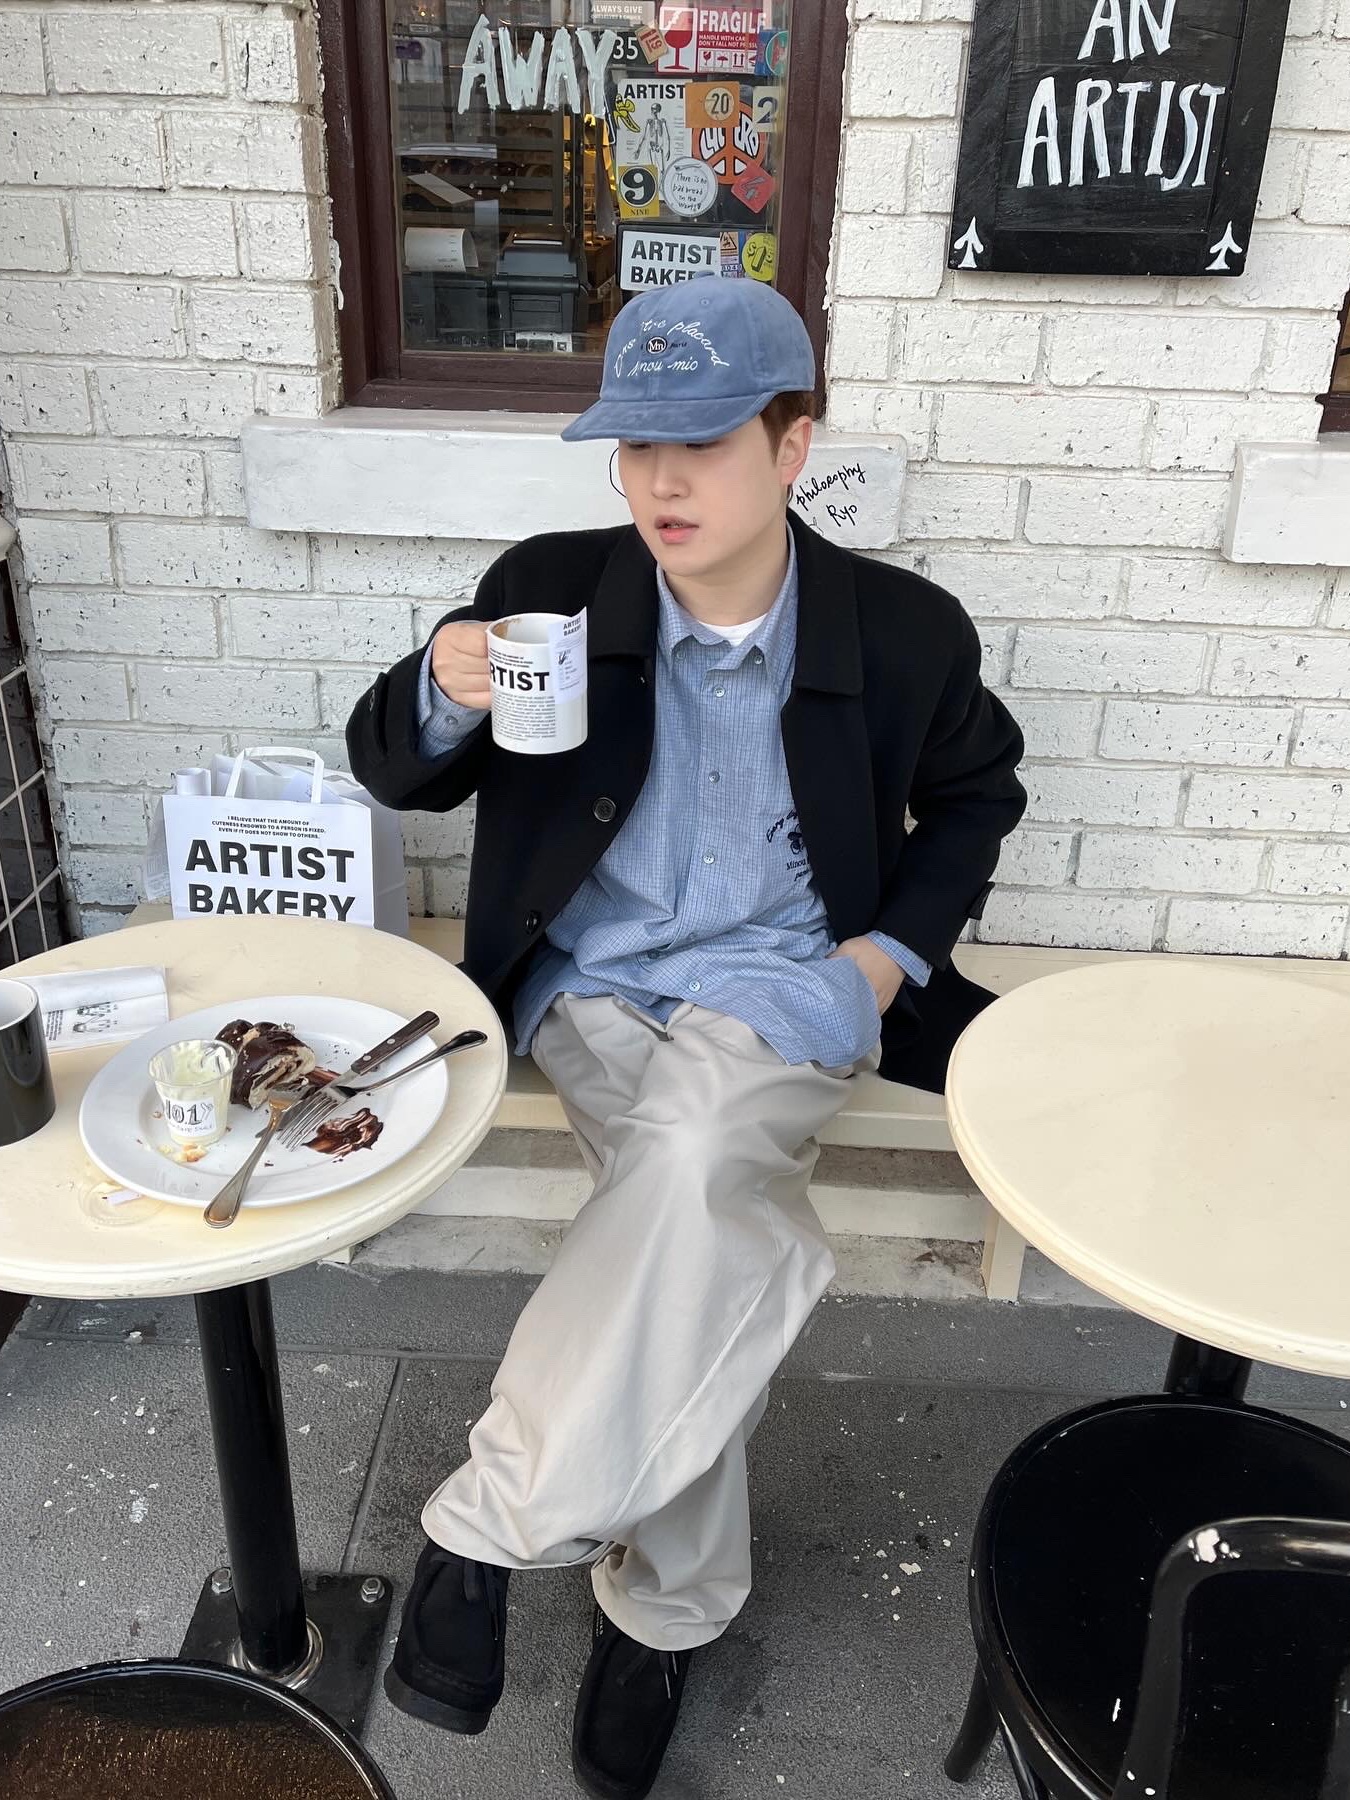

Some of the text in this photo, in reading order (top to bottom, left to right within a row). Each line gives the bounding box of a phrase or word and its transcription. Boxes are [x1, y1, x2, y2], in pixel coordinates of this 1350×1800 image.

[591, 5, 643, 14] ALWAYS GIVE
[1077, 0, 1176, 63] AN
[458, 14, 617, 118] AWAY
[624, 84, 686, 100] ARTIST
[711, 93, 730, 114] 20
[1016, 76, 1226, 192] ARTIST
[622, 168, 656, 205] 9
[630, 208, 650, 216] NINE
[631, 240, 717, 265] ARTIST
[490, 661, 550, 692] RTIST
[185, 839, 355, 883] ARTIST
[188, 883, 356, 922] BAKERY
